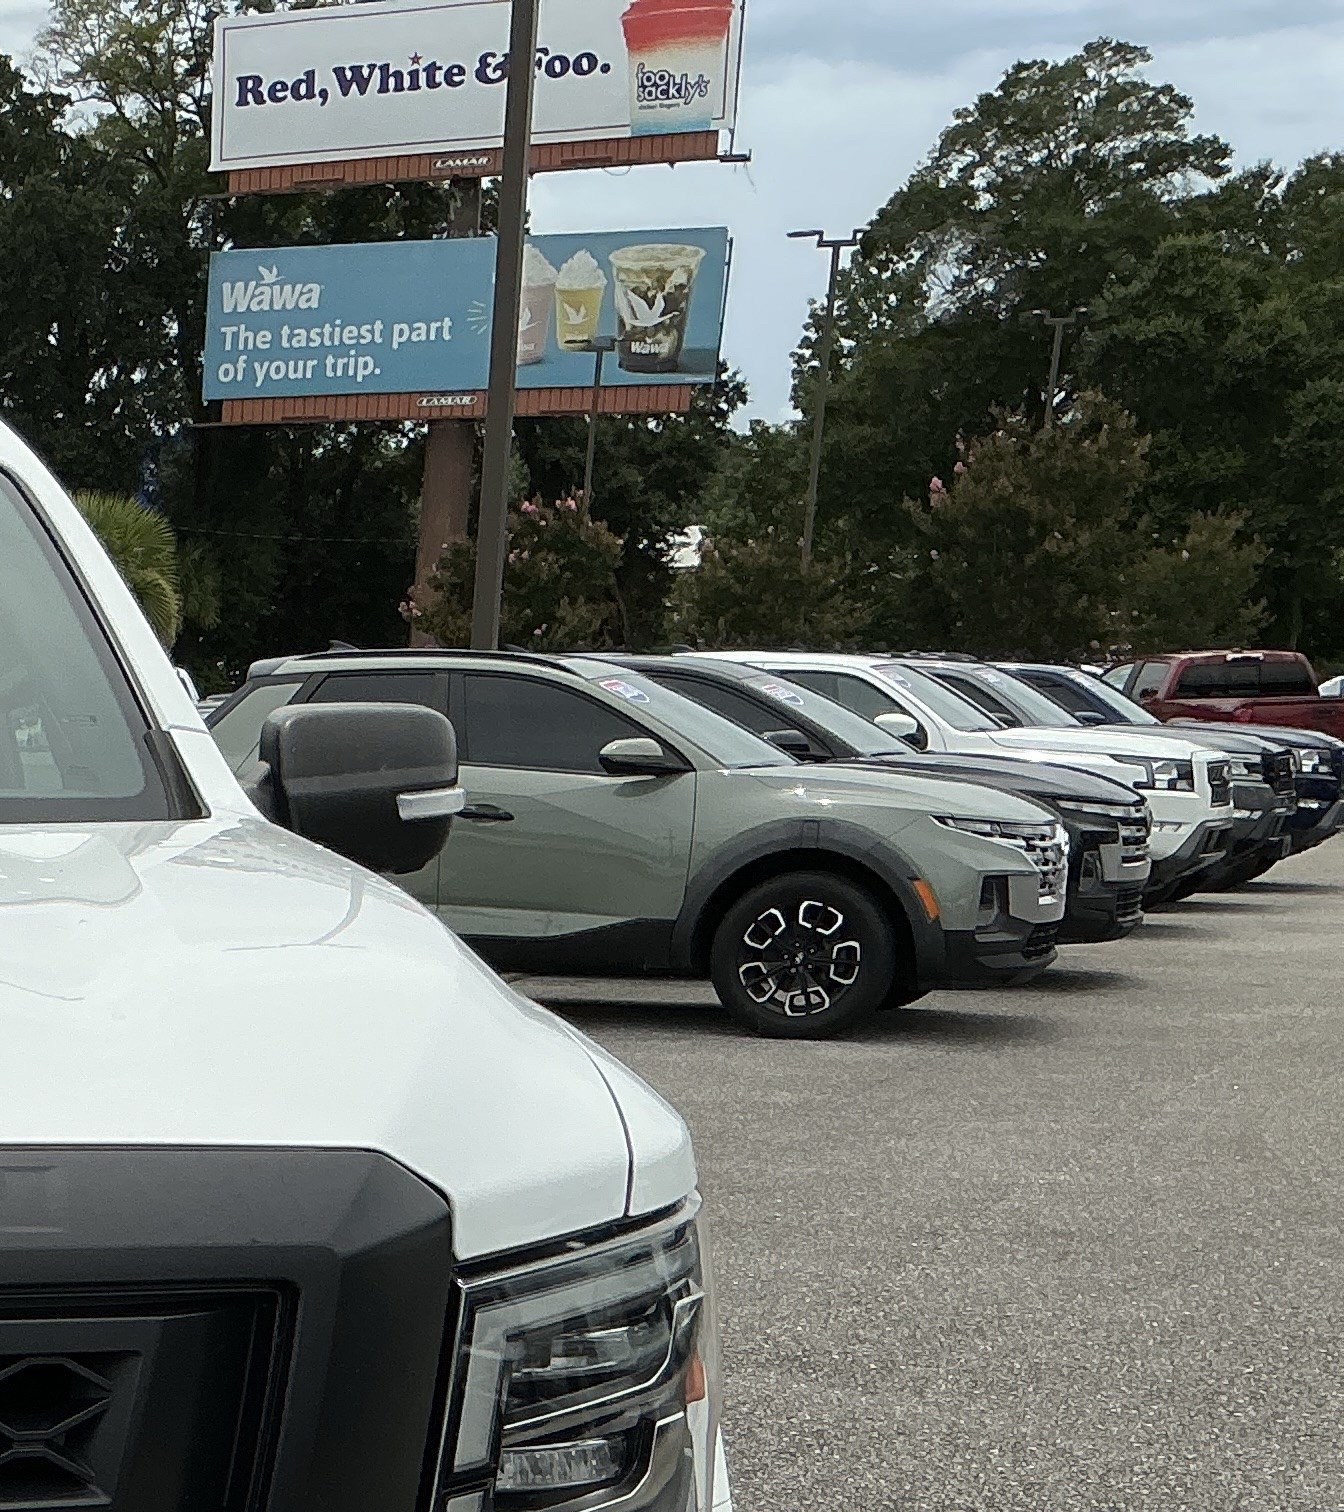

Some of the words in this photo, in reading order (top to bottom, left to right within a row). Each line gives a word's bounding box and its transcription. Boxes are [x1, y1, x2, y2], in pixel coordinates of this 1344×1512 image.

[234, 69, 329, 107] Red,
[331, 51, 466, 98] White
[474, 51, 510, 84] &
[636, 62, 671, 87] foo
[636, 73, 710, 105] sackly's
[435, 156, 490, 168] LAMAR
[221, 281, 322, 314] Wawa
[219, 323, 273, 351] The
[280, 319, 384, 349] tastiest
[391, 317, 454, 350] part
[217, 354, 247, 383] of
[252, 358, 318, 388] your
[325, 349, 381, 382] trip.
